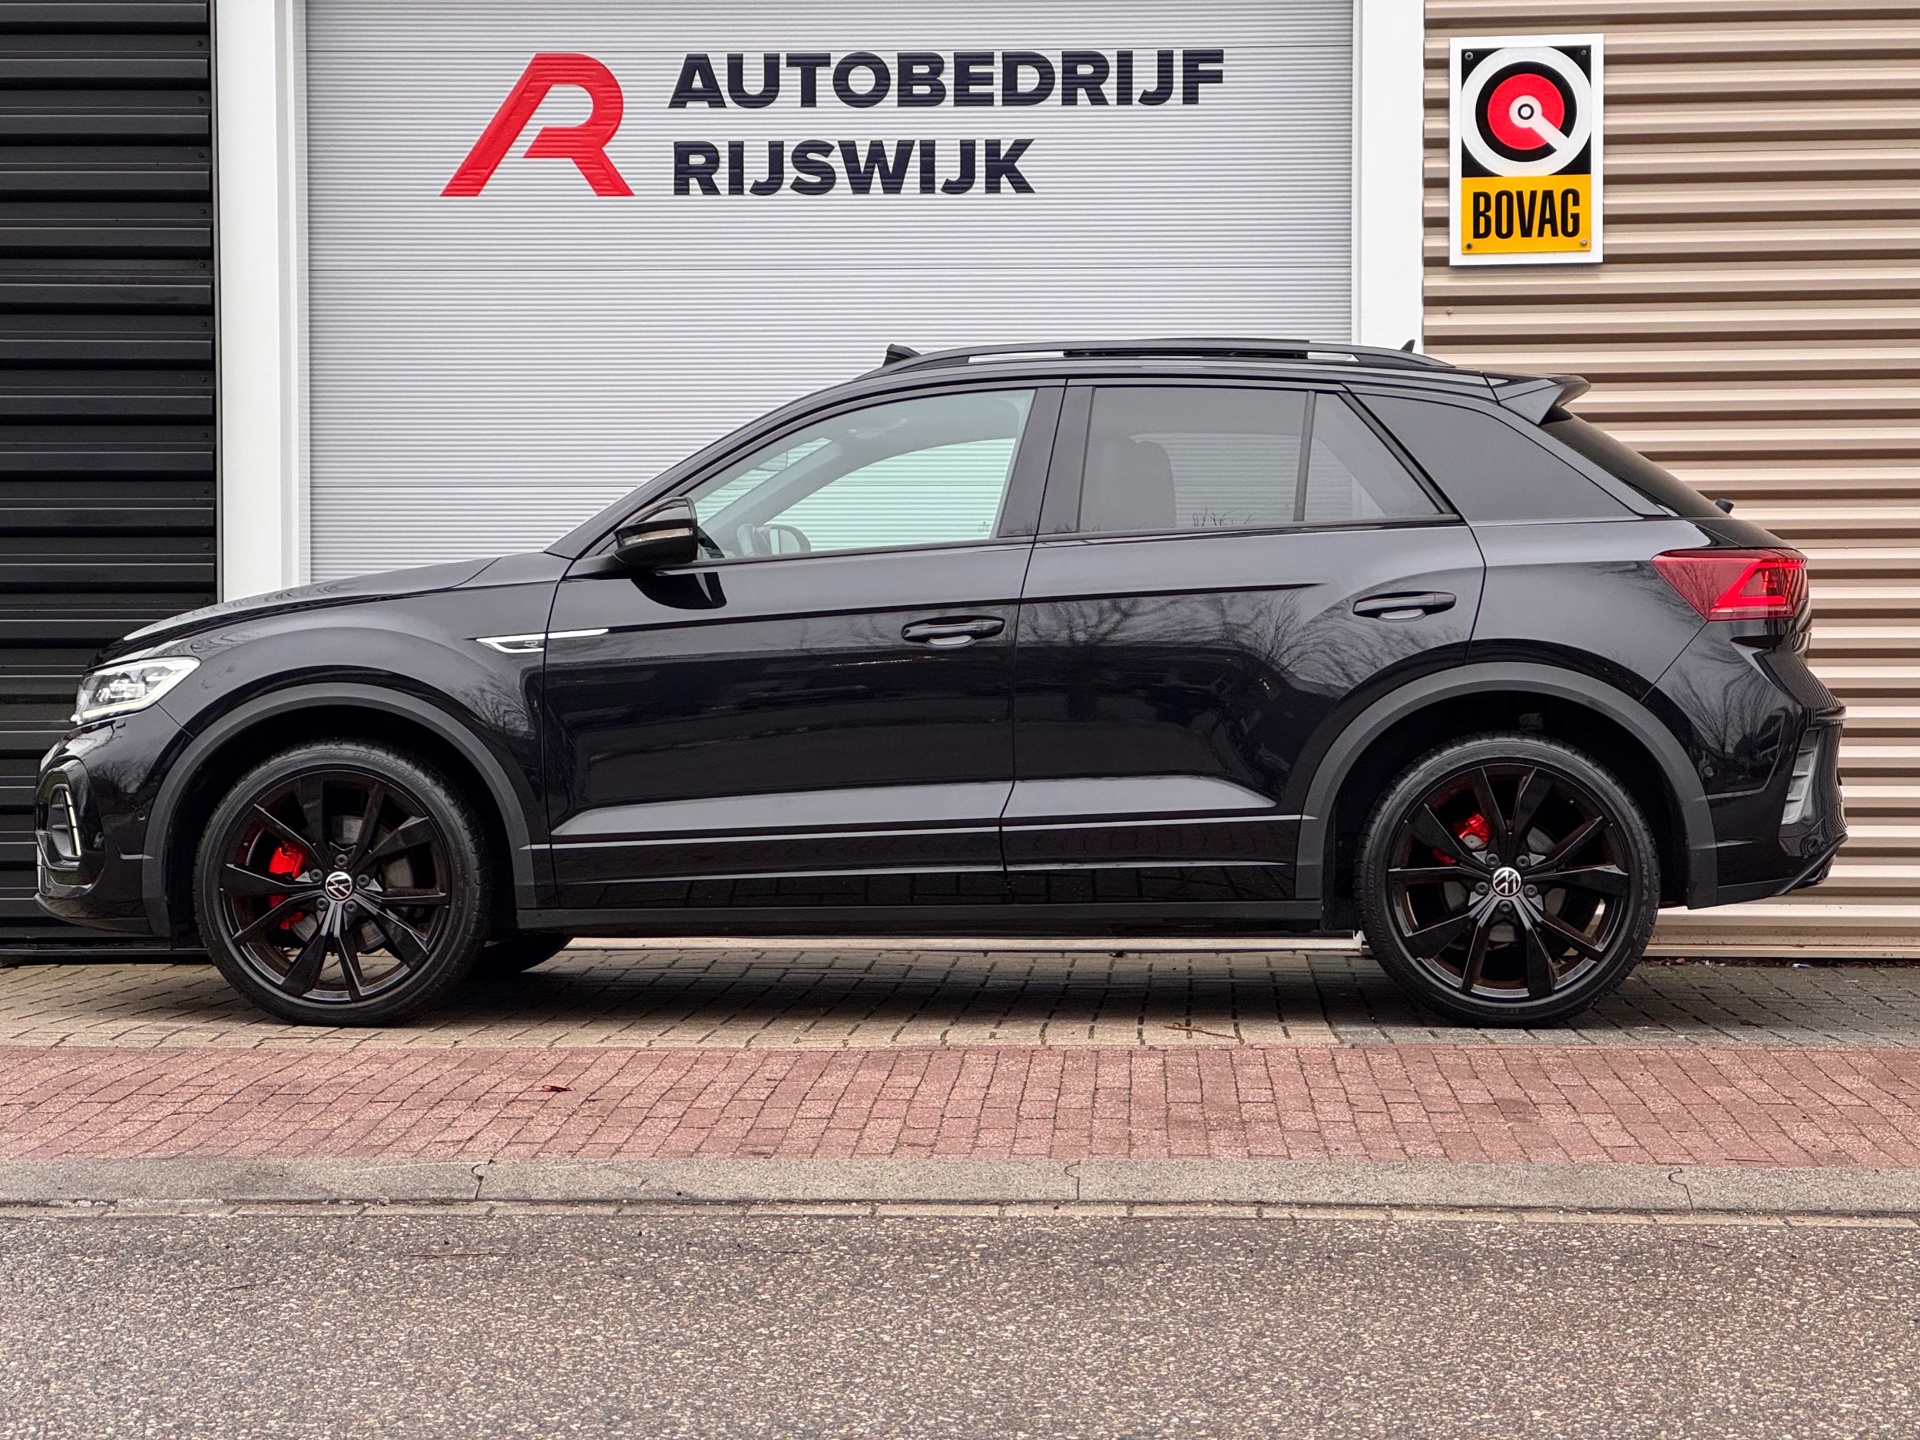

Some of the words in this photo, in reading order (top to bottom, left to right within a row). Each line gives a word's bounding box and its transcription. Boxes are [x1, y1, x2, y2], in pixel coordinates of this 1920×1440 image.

[669, 50, 1224, 109] AUTOBEDRIJF
[673, 139, 1035, 195] RIJSWIJK
[1472, 188, 1581, 239] BOVAG
